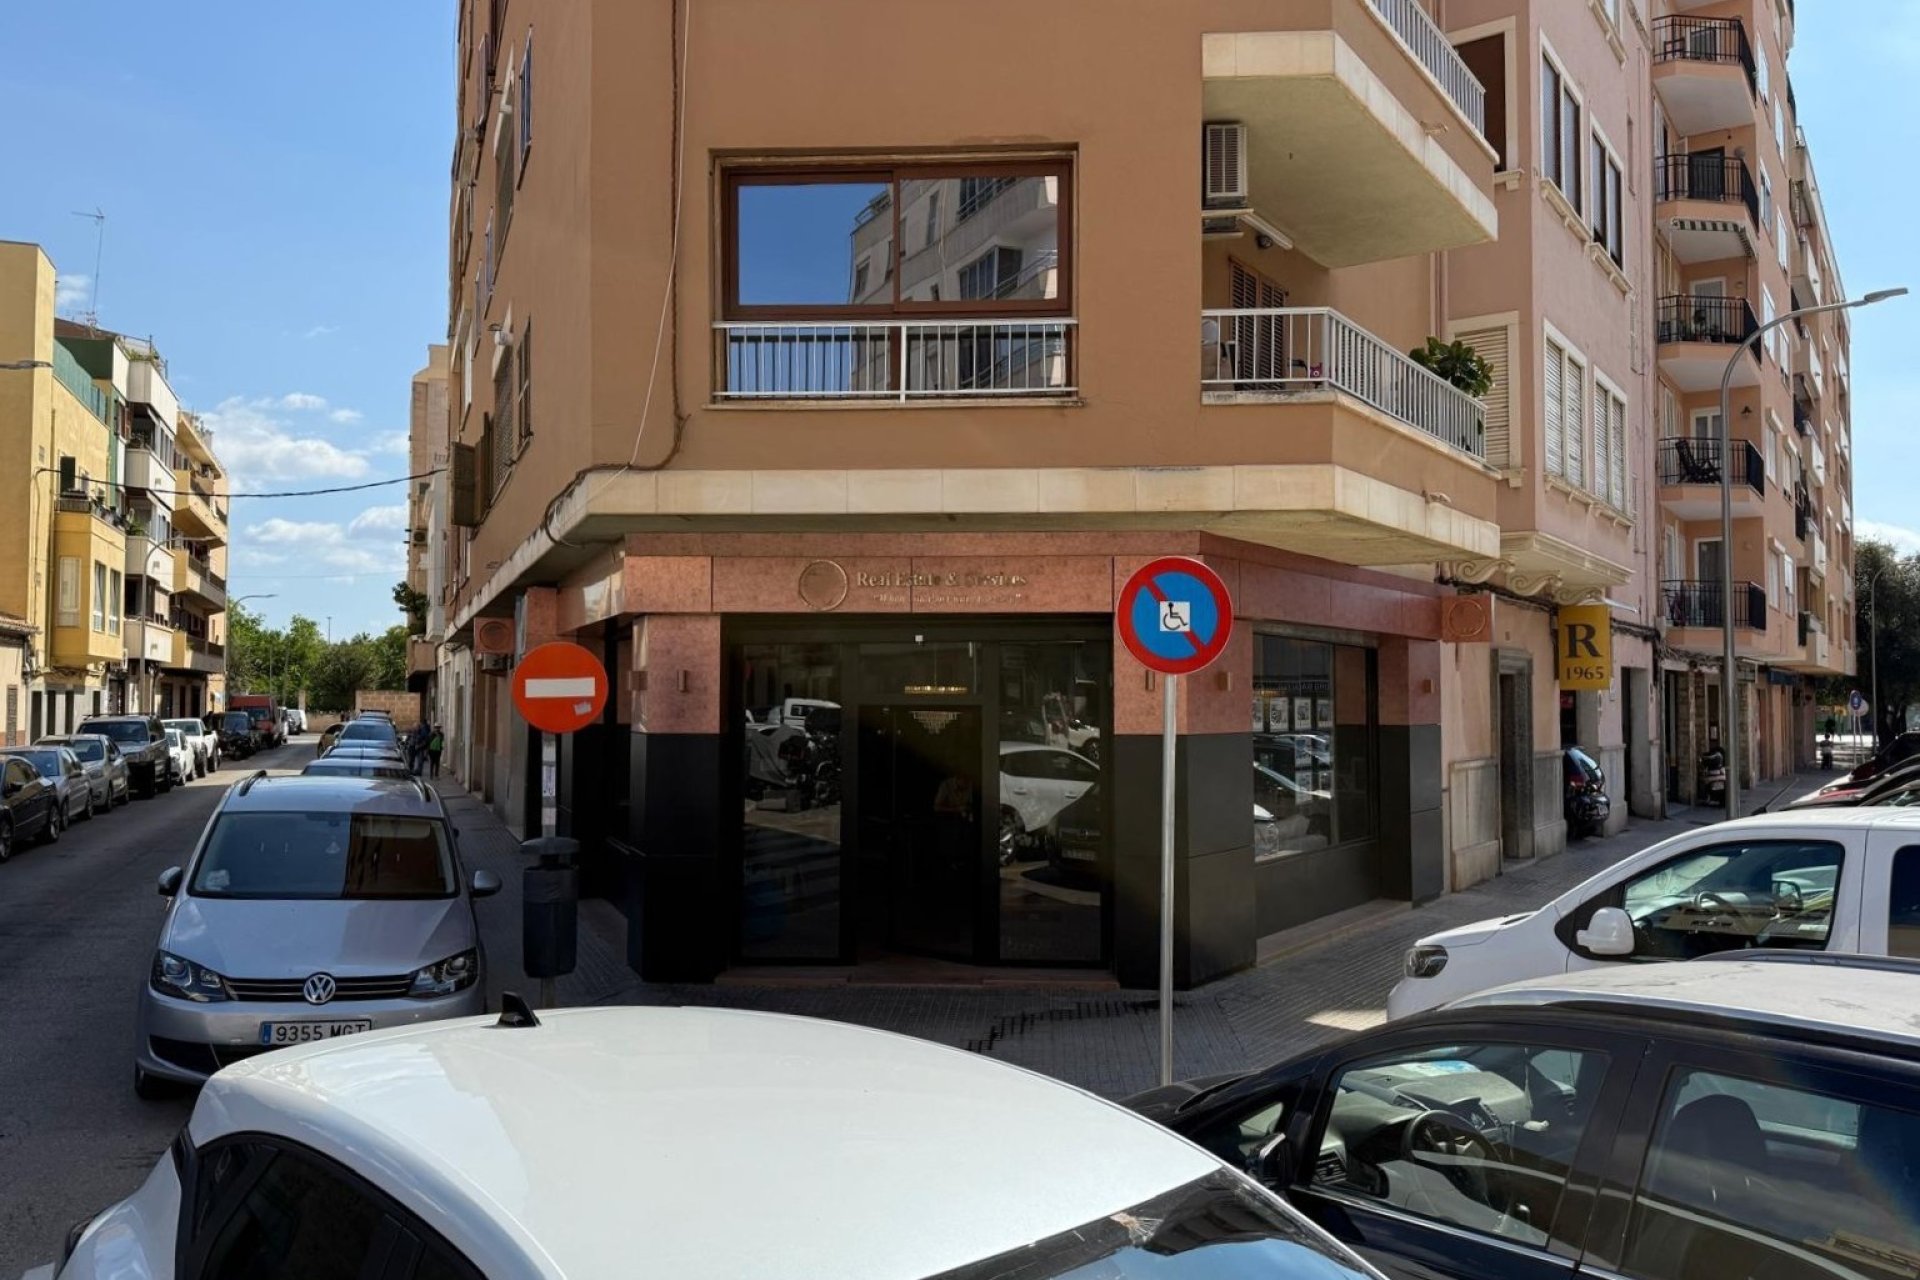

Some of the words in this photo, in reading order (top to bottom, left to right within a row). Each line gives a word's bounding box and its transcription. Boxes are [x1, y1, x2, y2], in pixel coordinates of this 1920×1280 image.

[857, 571, 891, 587] Real
[945, 571, 958, 587] &
[1564, 623, 1603, 658] R
[1566, 665, 1604, 680] 1965
[304, 973, 336, 1004] VW
[276, 1025, 323, 1041] 9355
